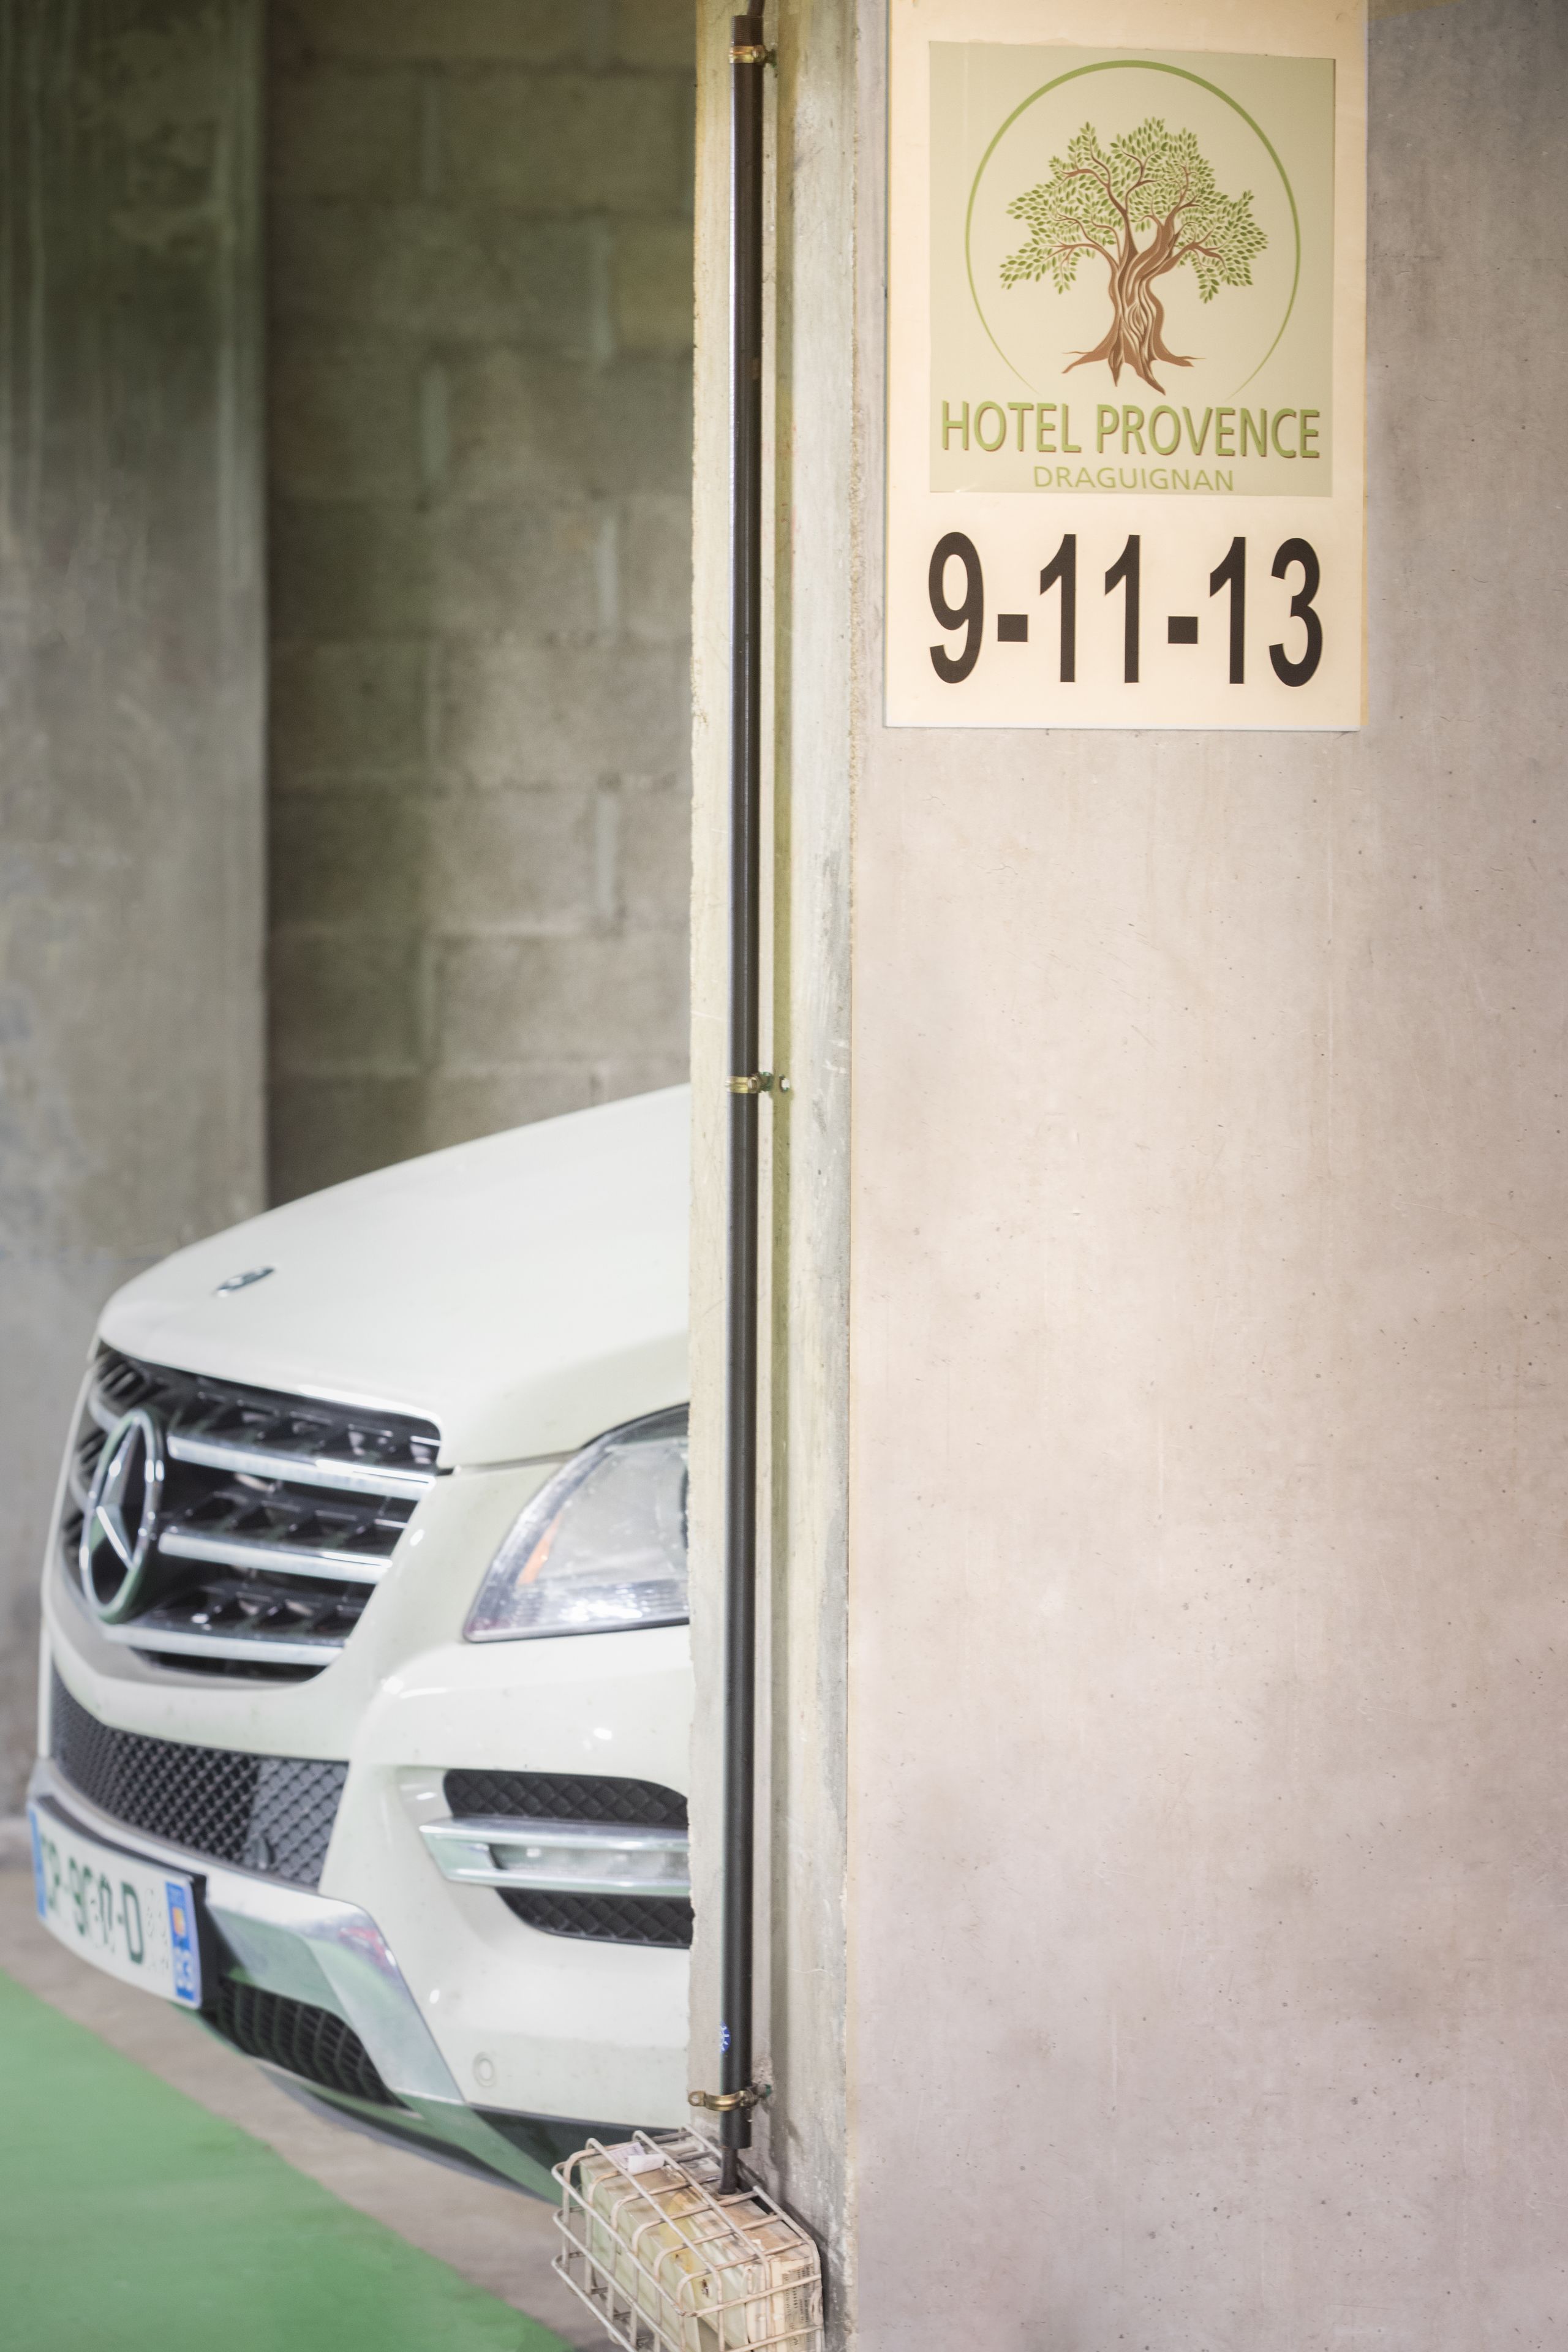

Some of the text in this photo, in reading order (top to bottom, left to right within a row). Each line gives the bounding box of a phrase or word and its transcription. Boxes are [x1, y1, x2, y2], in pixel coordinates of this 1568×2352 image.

[941, 400, 1321, 459] HOTEL PROVENCE
[1033, 466, 1234, 491] DRAGUIGNAN
[928, 531, 1323, 688] 9-11-13
